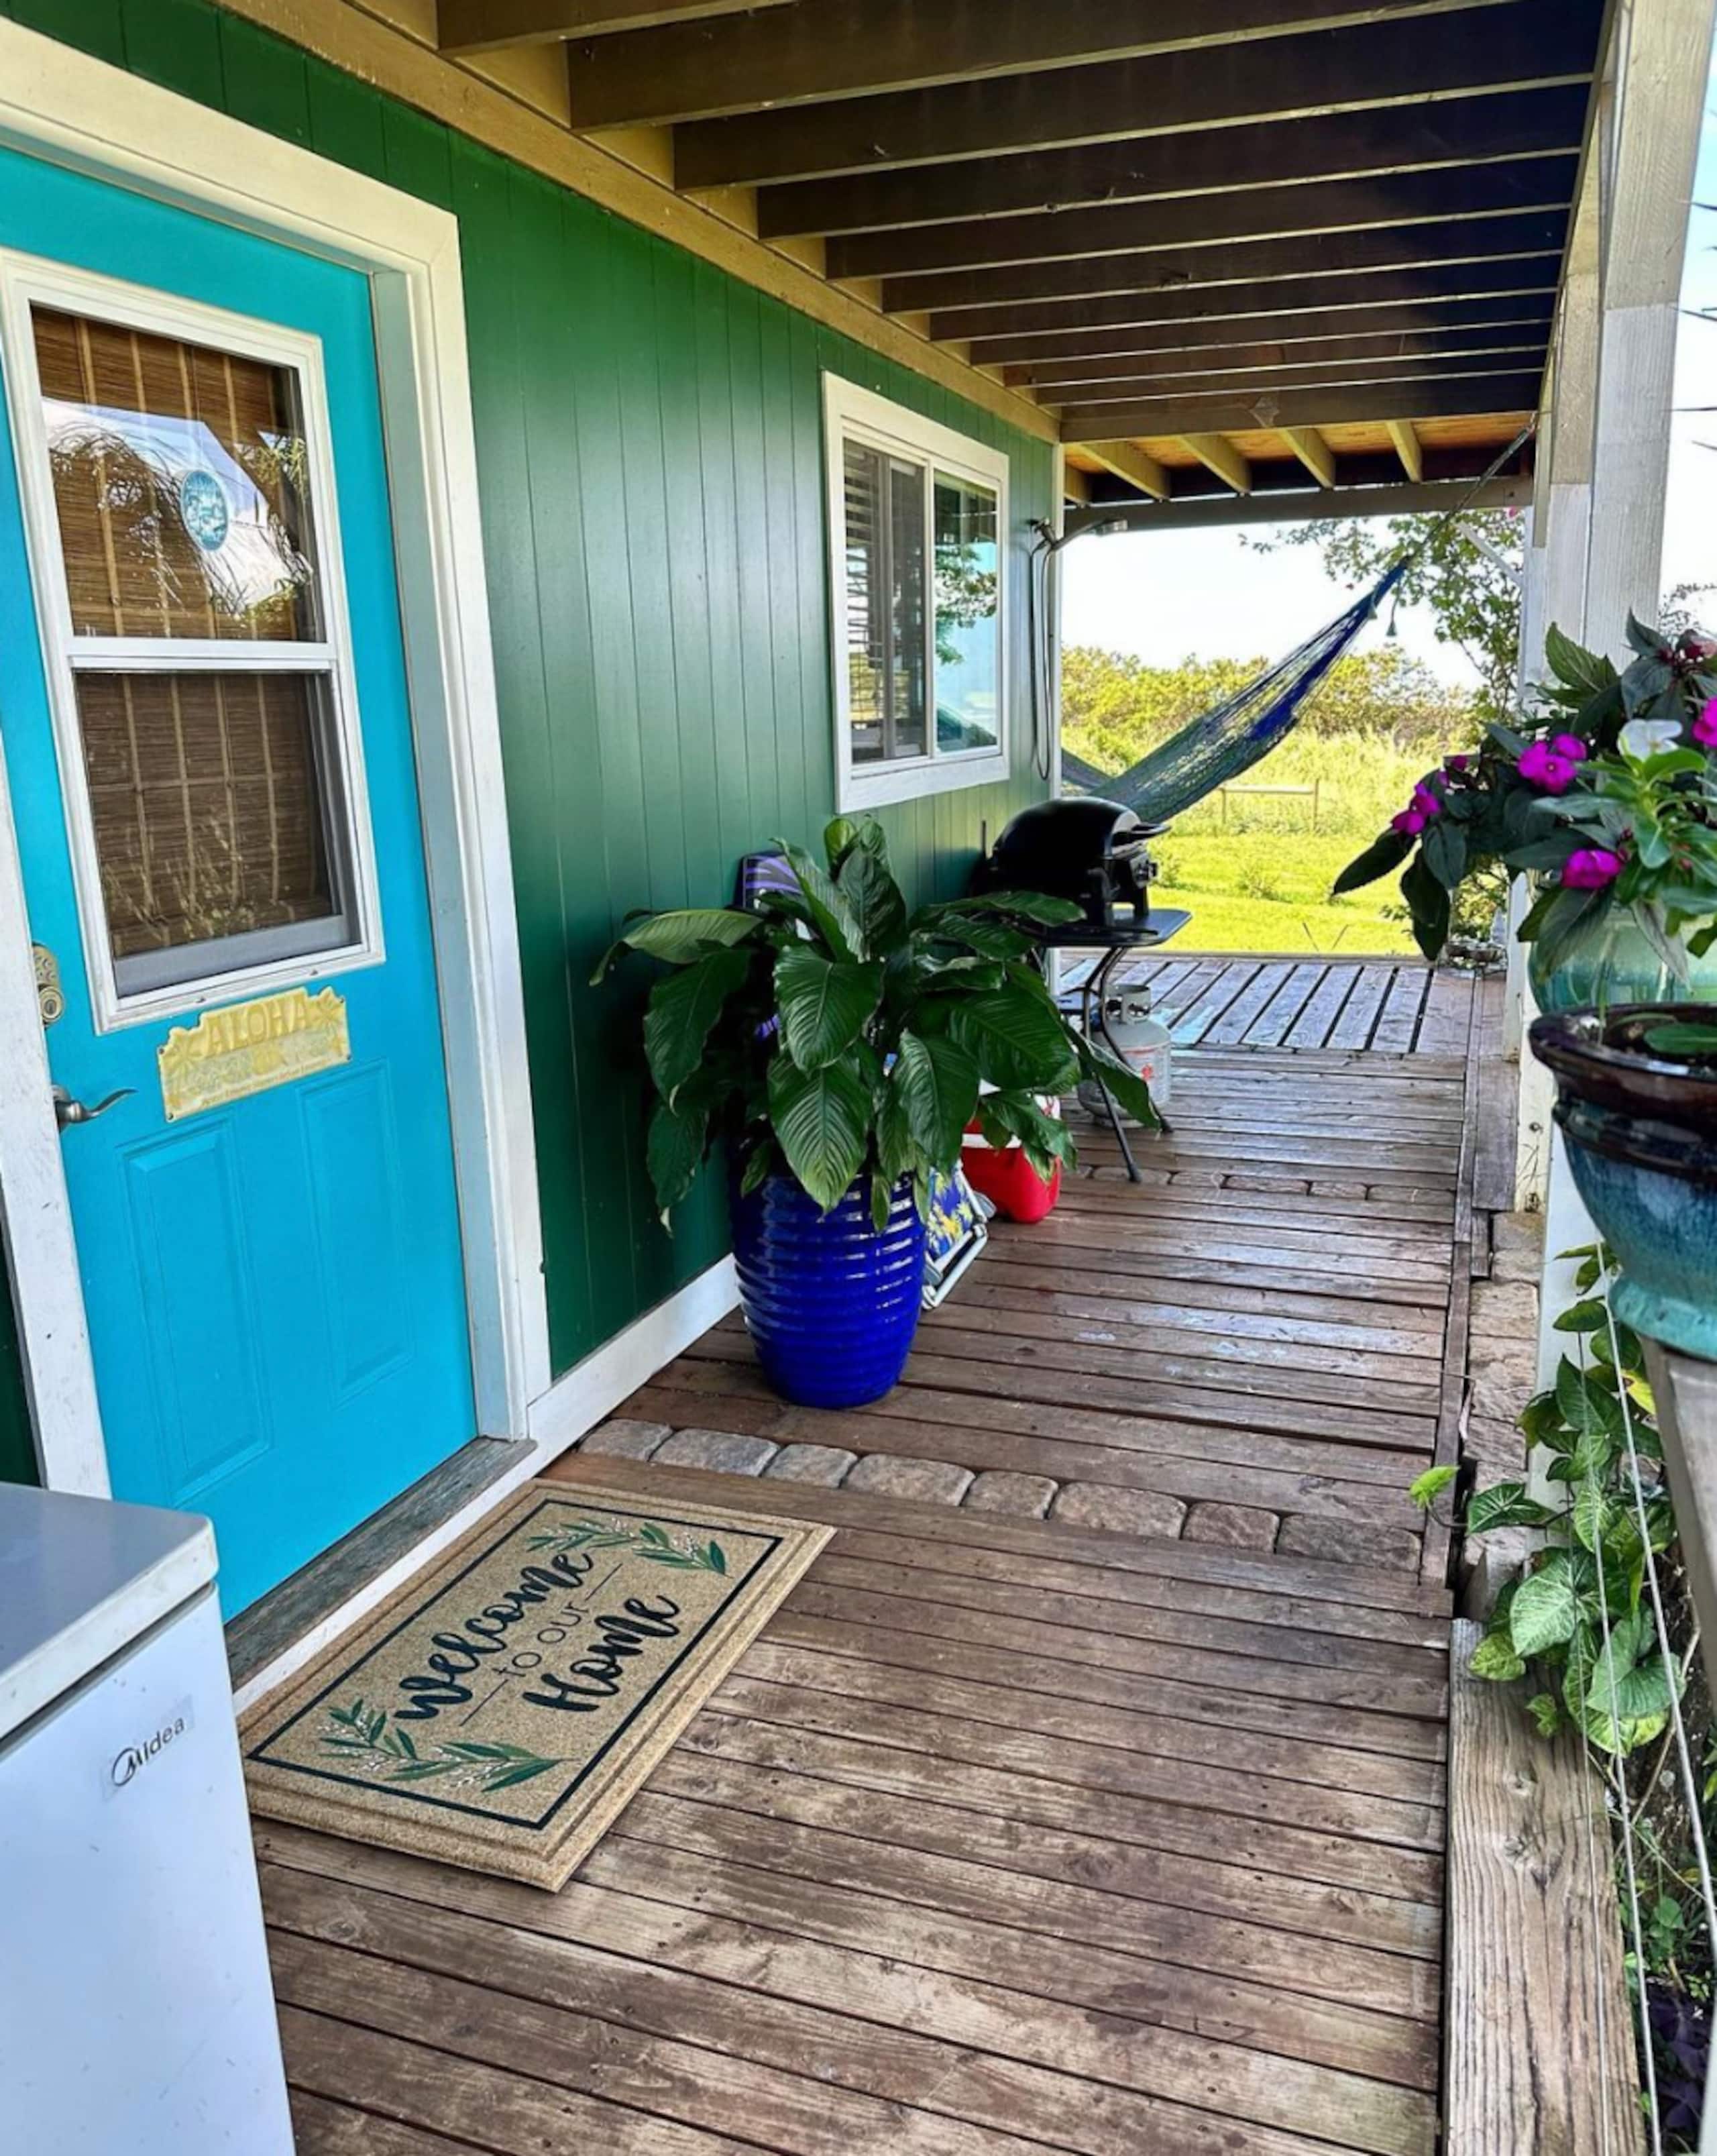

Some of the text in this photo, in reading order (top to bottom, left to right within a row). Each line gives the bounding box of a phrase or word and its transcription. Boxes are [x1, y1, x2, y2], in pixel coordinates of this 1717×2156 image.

[203, 993, 309, 1056] ALOHA
[492, 1601, 590, 1677] to our
[522, 1595, 680, 1713] Home
[111, 1717, 185, 1787] Midea
